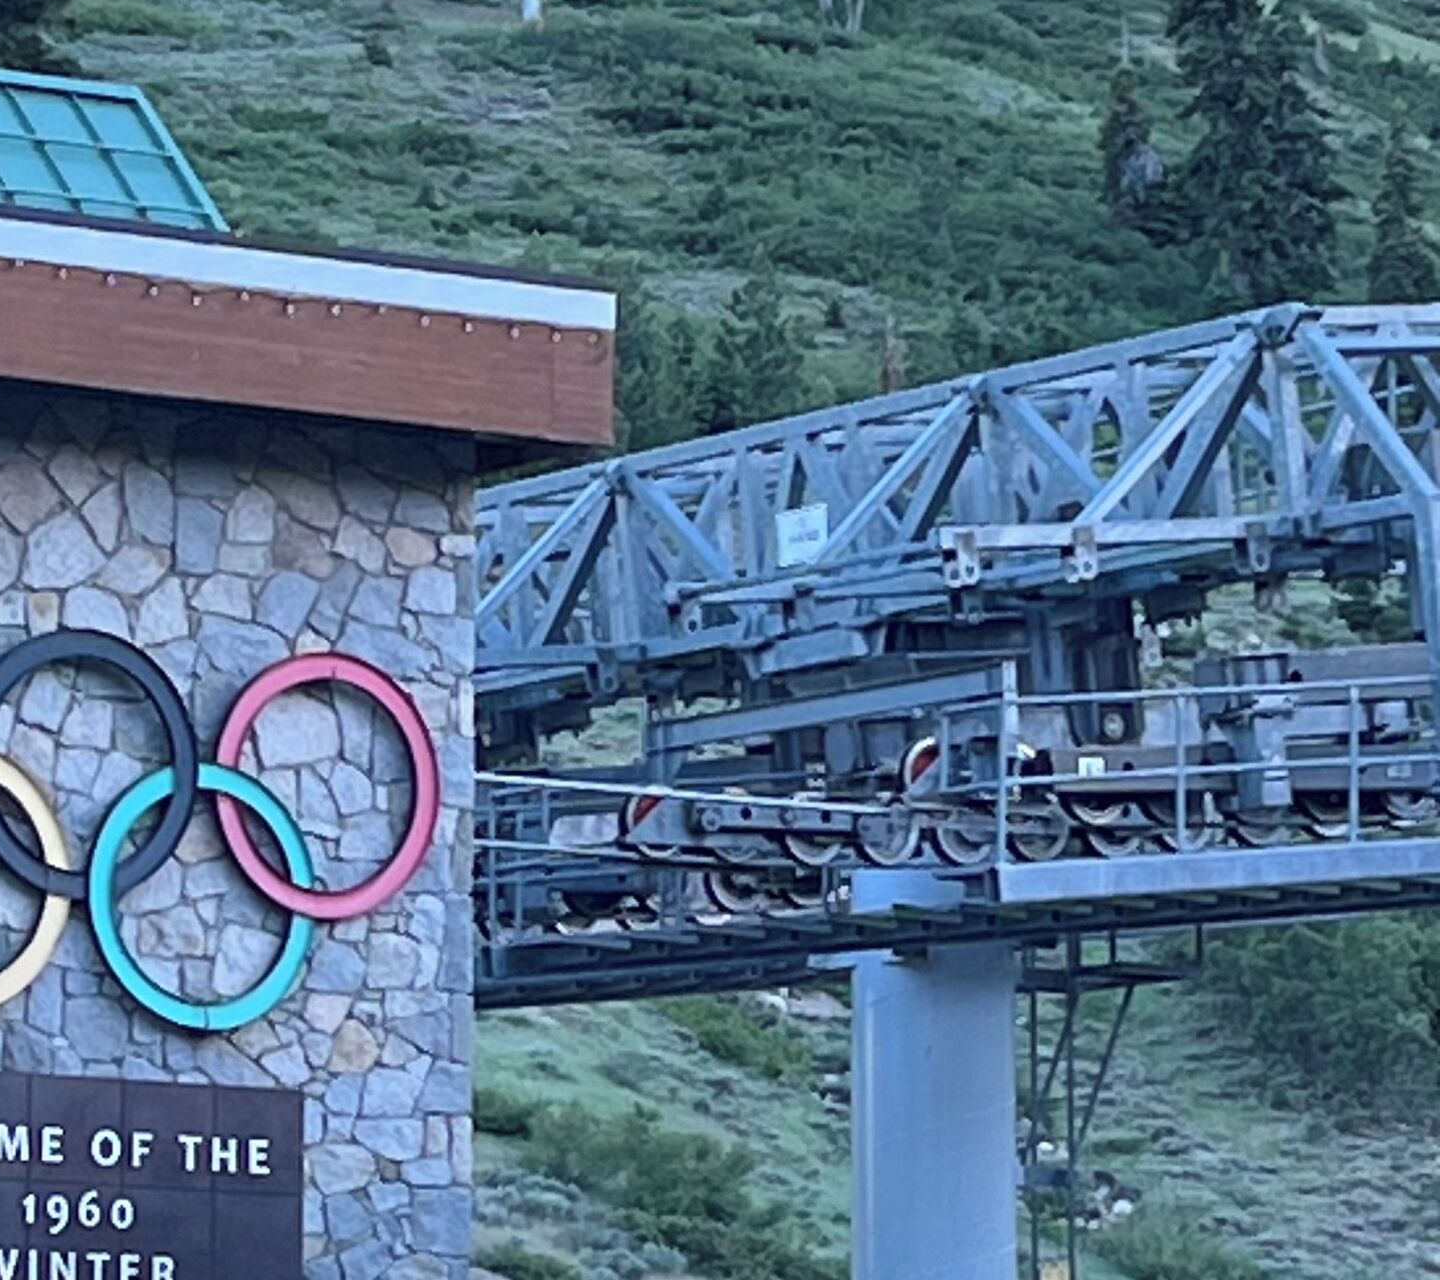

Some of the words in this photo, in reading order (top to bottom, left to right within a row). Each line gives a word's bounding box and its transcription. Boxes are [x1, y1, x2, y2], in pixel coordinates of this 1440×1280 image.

[91, 1128, 154, 1168] OF
[177, 1133, 271, 1176] THE
[22, 1189, 134, 1235] 1960
